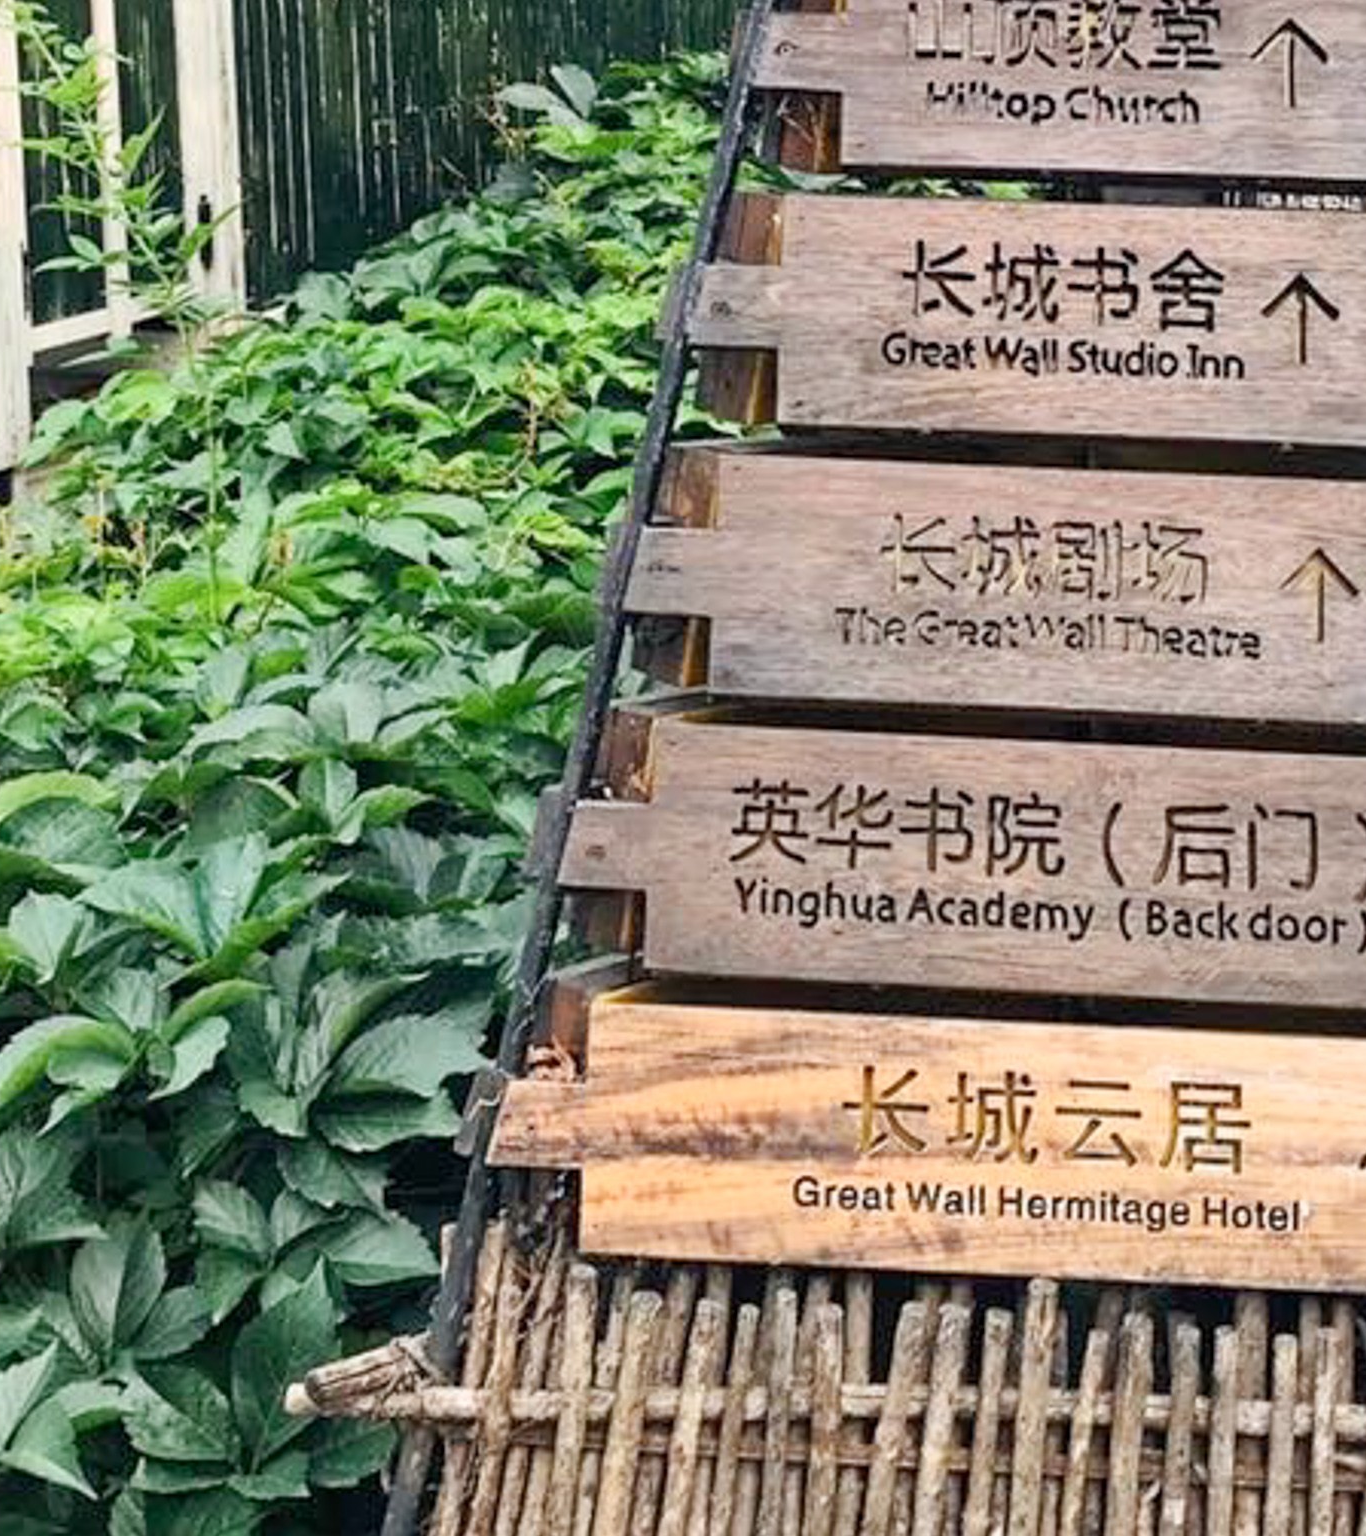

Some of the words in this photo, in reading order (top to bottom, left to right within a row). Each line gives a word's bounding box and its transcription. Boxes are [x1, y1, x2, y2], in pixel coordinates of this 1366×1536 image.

[925, 81, 1055, 124] Hilltop
[1062, 84, 1201, 125] Church
[902, 239, 1227, 334] 长城书舍
[881, 331, 976, 371] Great
[983, 334, 1060, 373] Wall
[1066, 337, 1177, 377] Studio
[1185, 343, 1246, 381] Inn
[881, 513, 1211, 602] 长城剧场
[836, 606, 906, 645] The
[916, 611, 1019, 651] Great
[1024, 613, 1107, 654] Wall
[1112, 615, 1263, 660] Theatre
[733, 875, 897, 930] Yinghua
[906, 892, 1095, 940] Academy
[841, 1064, 1253, 1175] 长城云居
[792, 1177, 897, 1211] Great
[905, 1181, 988, 1216] Wall
[998, 1185, 1191, 1231] Hermitage
[1202, 1197, 1301, 1232] Hotel
